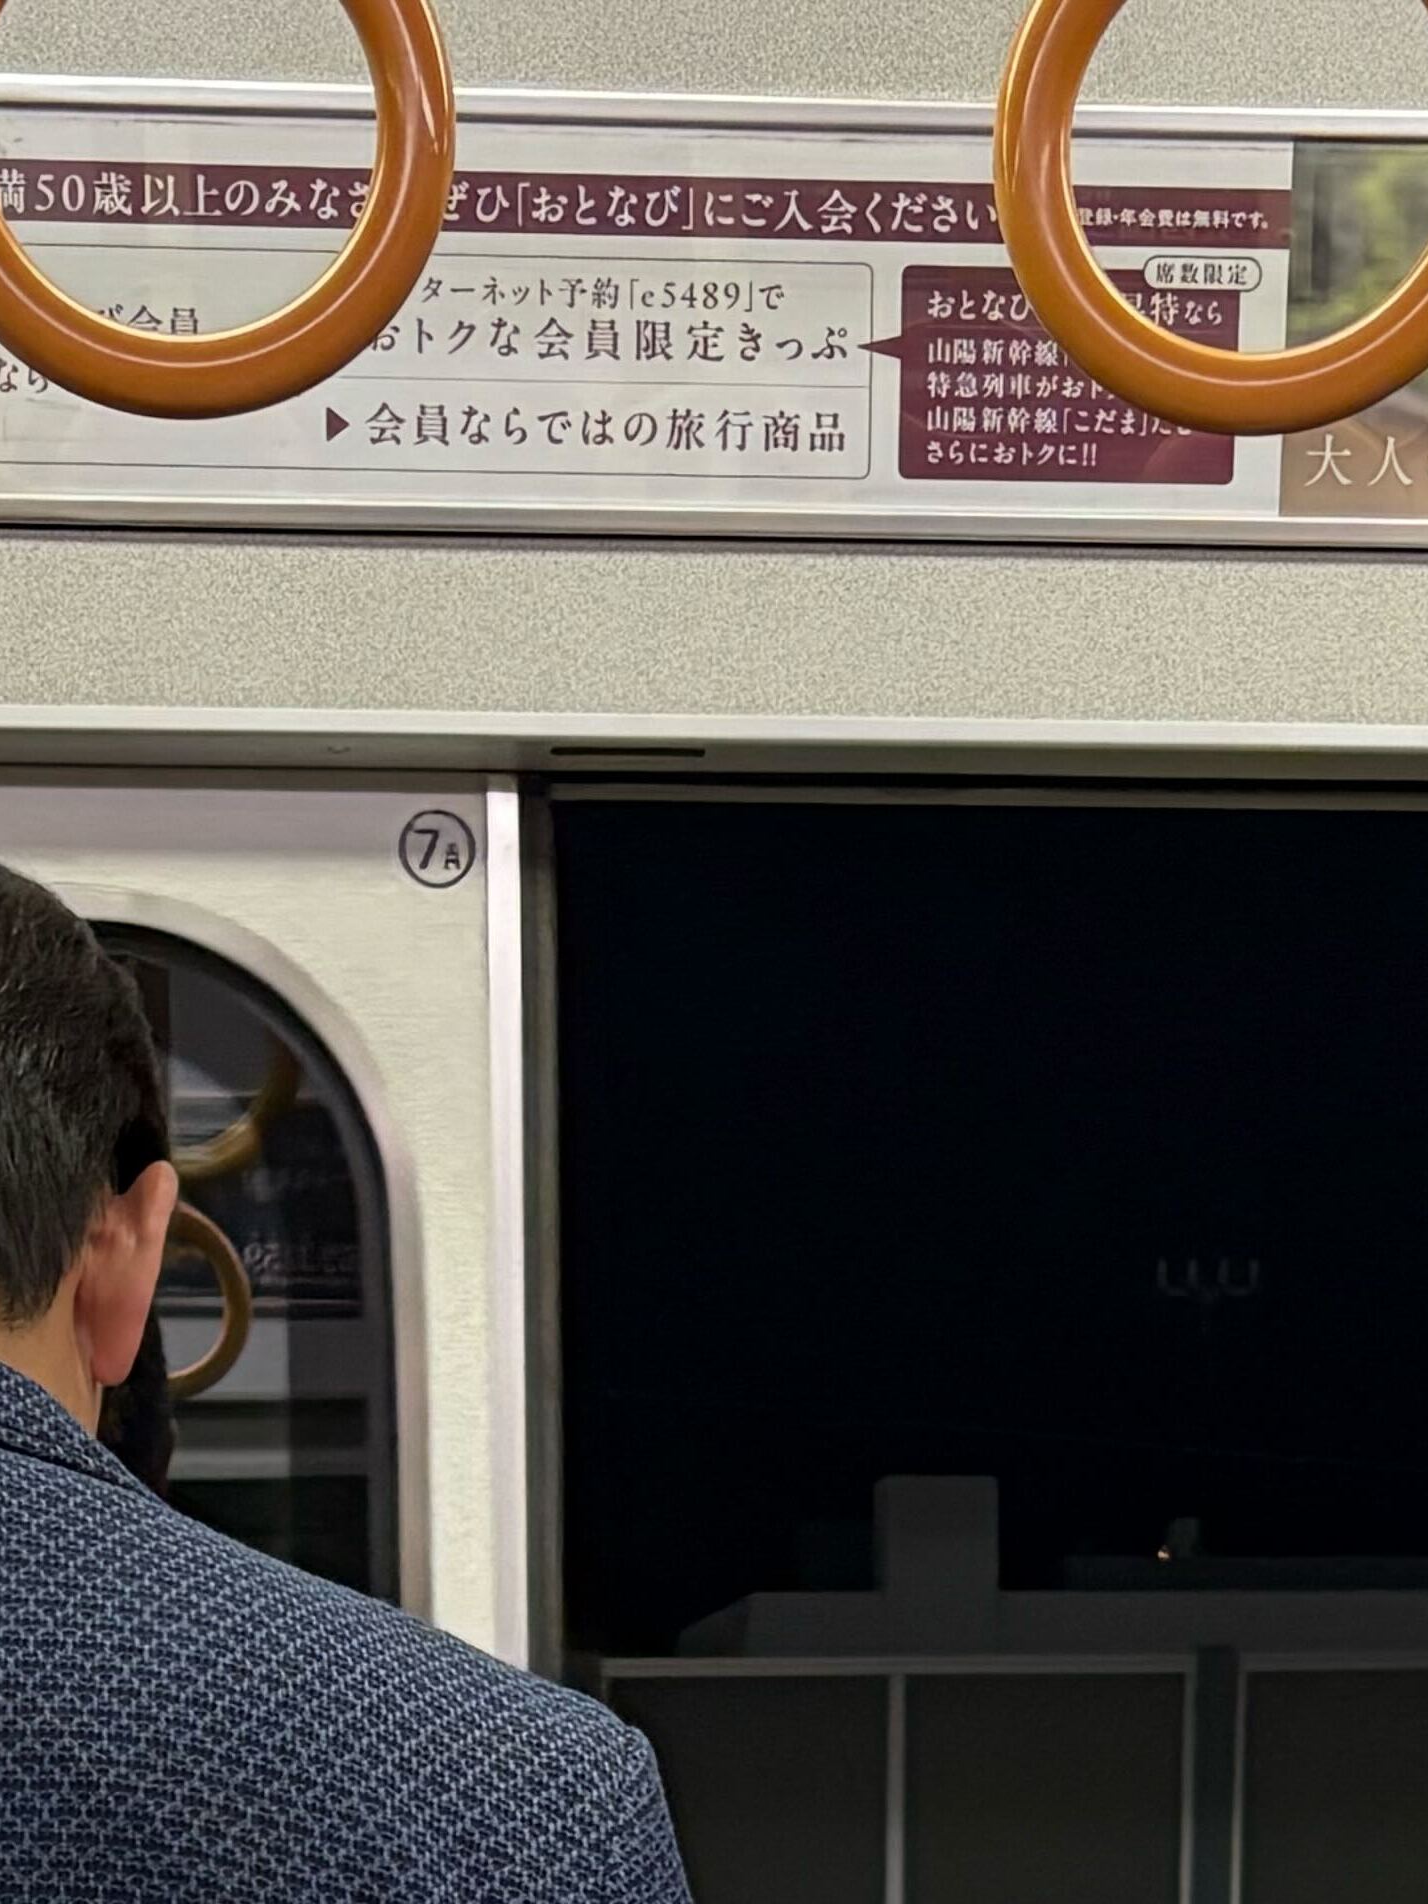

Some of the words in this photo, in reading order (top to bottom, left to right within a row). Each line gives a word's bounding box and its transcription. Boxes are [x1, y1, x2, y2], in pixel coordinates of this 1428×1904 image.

[1155, 262, 1249, 287] 席数限定
[365, 402, 847, 454] 会員ならではの旅行商品
